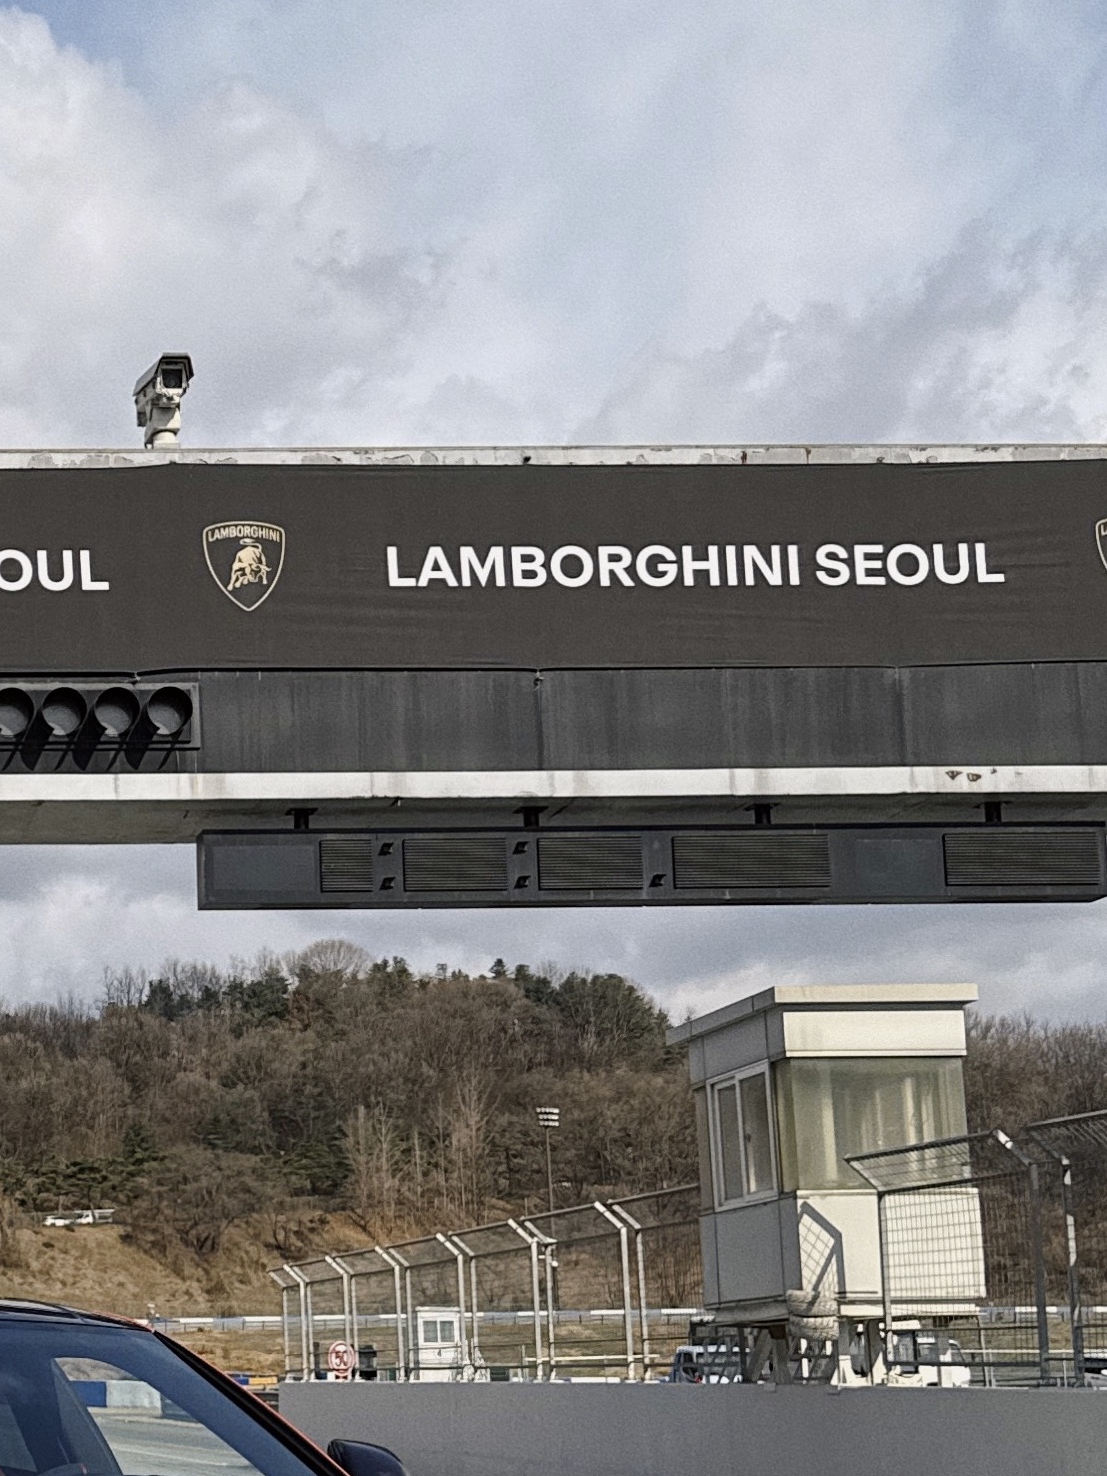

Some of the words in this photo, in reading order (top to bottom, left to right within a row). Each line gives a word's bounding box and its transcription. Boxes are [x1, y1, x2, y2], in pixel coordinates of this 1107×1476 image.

[207, 525, 281, 543] LAMBORGHINI
[386, 544, 801, 588] LAMBORGHINI
[815, 542, 1006, 586] SEOUL
